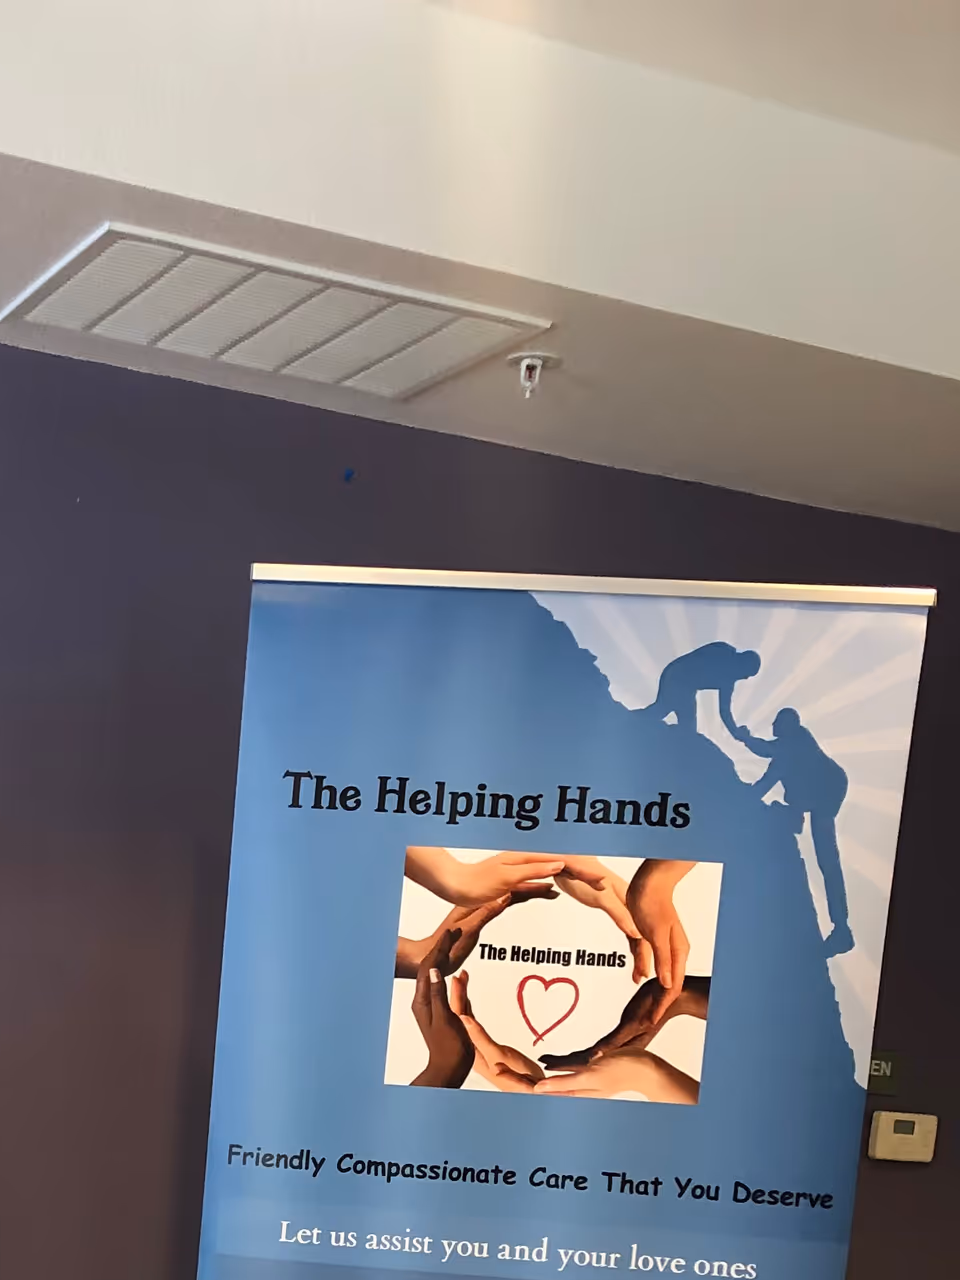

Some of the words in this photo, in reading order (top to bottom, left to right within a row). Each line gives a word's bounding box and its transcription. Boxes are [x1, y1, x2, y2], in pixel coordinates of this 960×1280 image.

[282, 770, 361, 811] The
[374, 776, 543, 831] Helping
[554, 785, 690, 828] Hands
[479, 944, 507, 961] The
[510, 945, 572, 967] Helping
[575, 949, 626, 968] Hands
[228, 1144, 326, 1177] Friendly
[337, 1153, 516, 1185] Compassionate
[529, 1167, 588, 1190] Care
[601, 1172, 663, 1196] That
[674, 1177, 720, 1201] You
[733, 1181, 833, 1209] Deserve
[279, 1221, 322, 1244] Let
[330, 1232, 357, 1247] us
[365, 1228, 433, 1253] assist
[441, 1240, 489, 1262] you
[497, 1237, 548, 1262] and
[557, 1249, 621, 1271] your
[629, 1244, 686, 1273] love
[694, 1260, 756, 1279] ones
